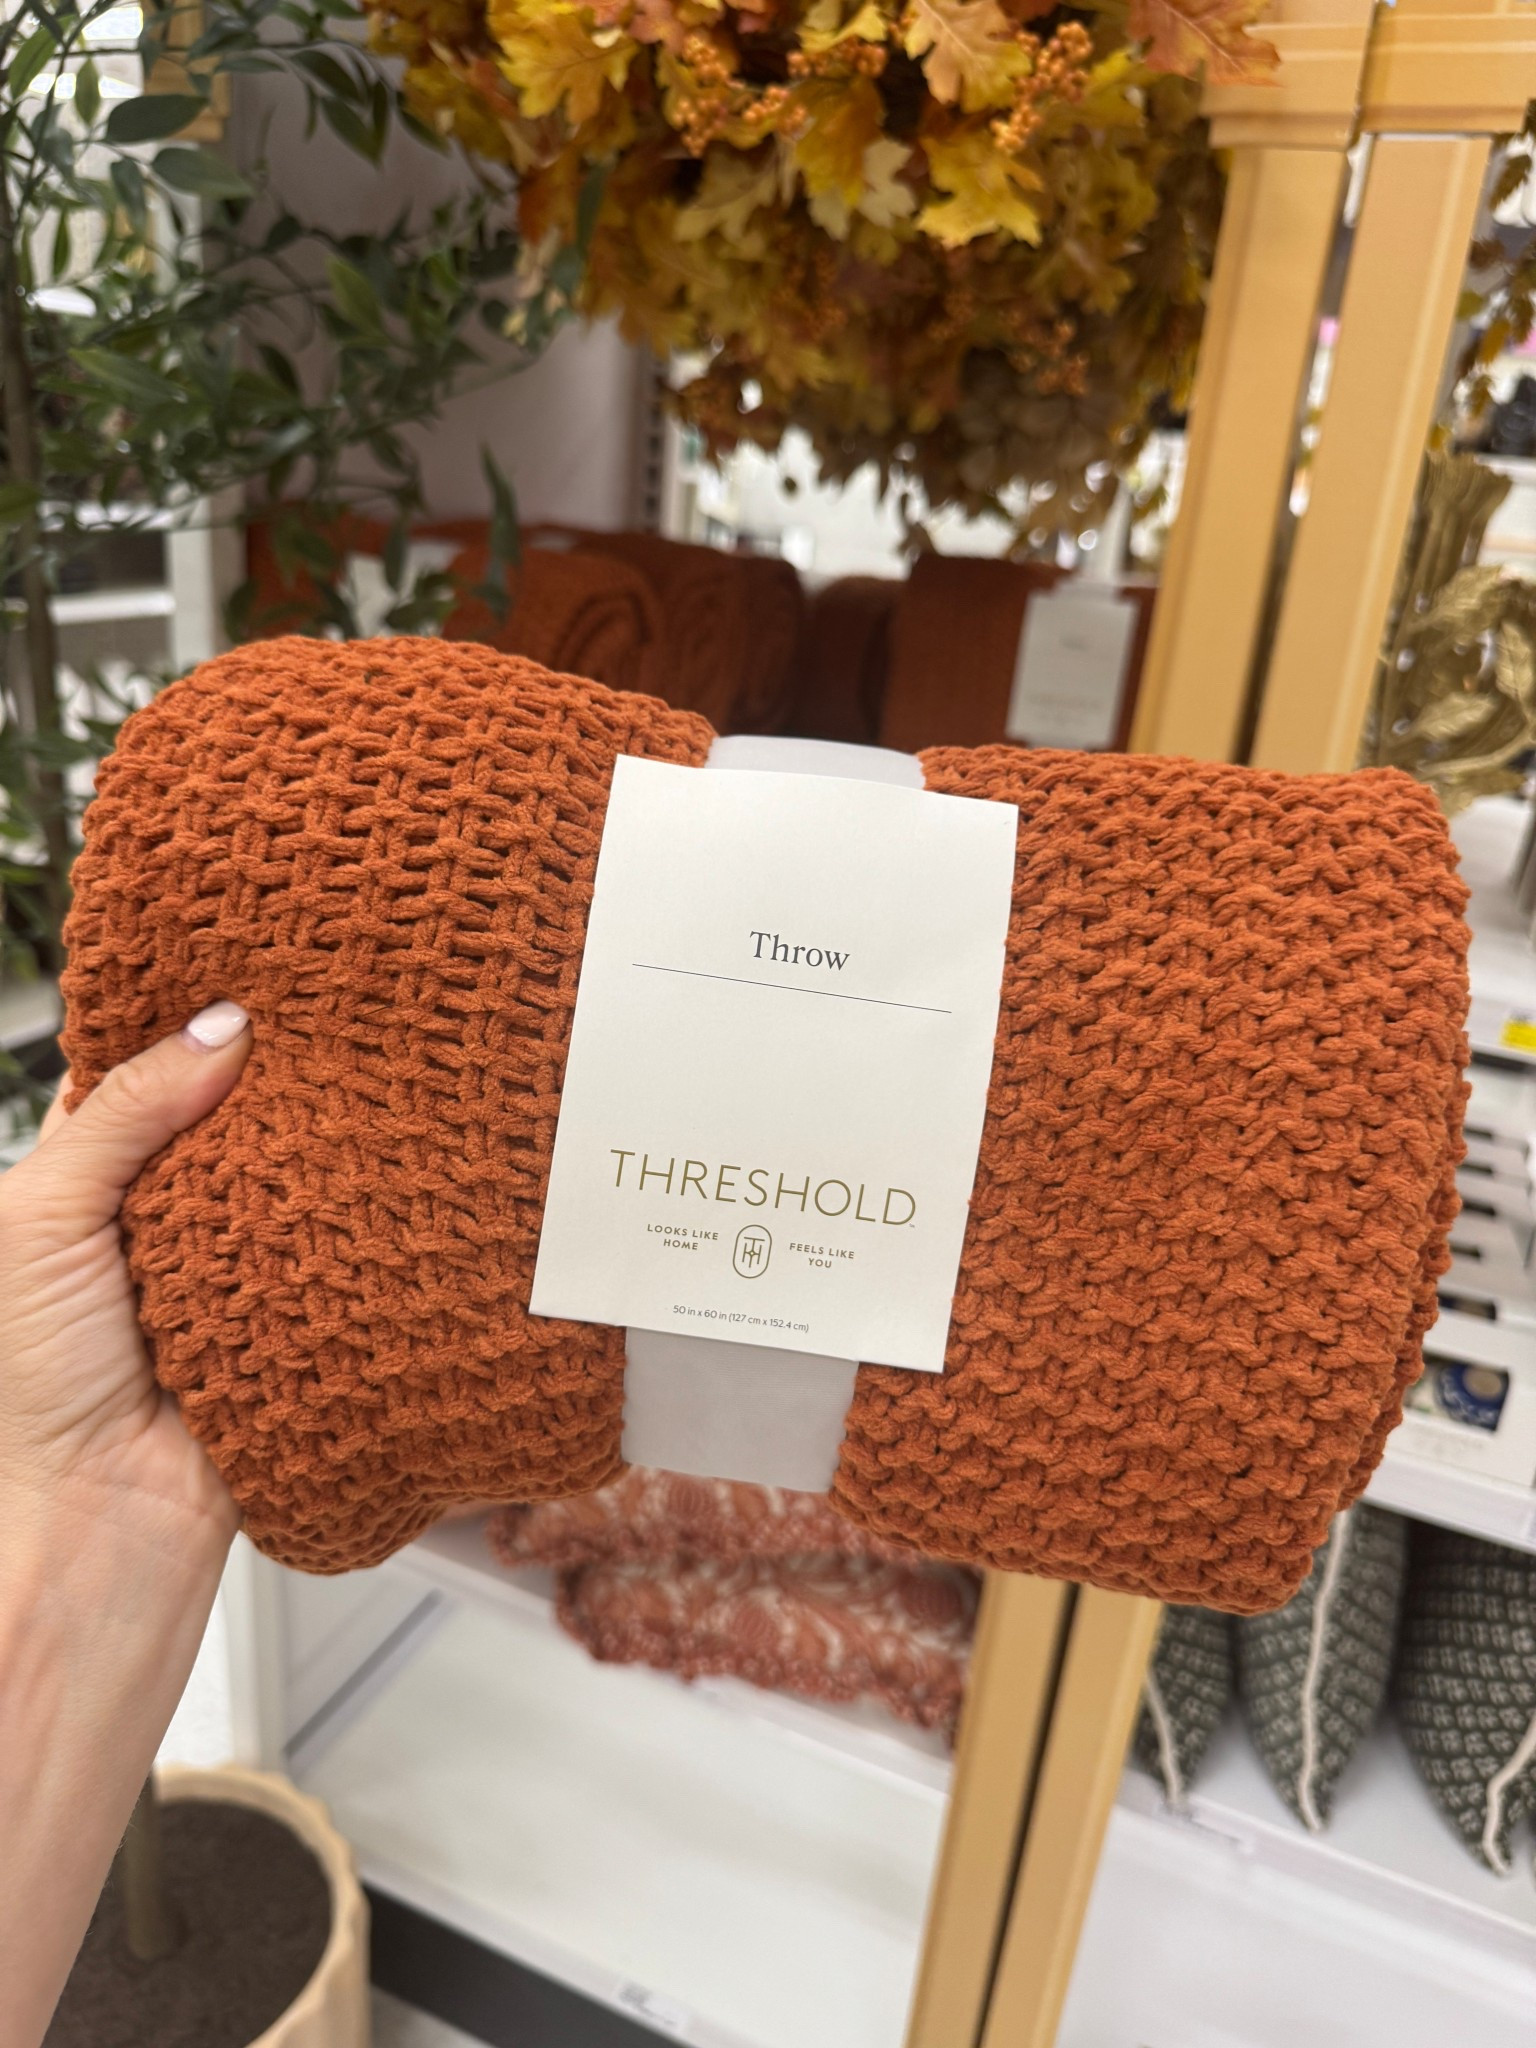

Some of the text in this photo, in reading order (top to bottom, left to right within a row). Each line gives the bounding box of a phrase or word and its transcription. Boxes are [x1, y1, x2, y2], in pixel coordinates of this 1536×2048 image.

[750, 931, 851, 972] Throw
[646, 1223, 719, 1241] LOOKS LIKE
[663, 1238, 699, 1251] HOME
[789, 1242, 855, 1260] FEELS LIKE
[808, 1257, 833, 1269] YOU
[673, 1304, 686, 1315] 50
[687, 1307, 696, 1316] in
[704, 1309, 718, 1319] 60
[719, 1311, 728, 1321] in
[728, 1312, 747, 1323] (127
[747, 1316, 762, 1326] cm
[762, 1318, 768, 1326] x
[770, 1318, 792, 1329] 152.4
[793, 1322, 810, 1333] cm)
